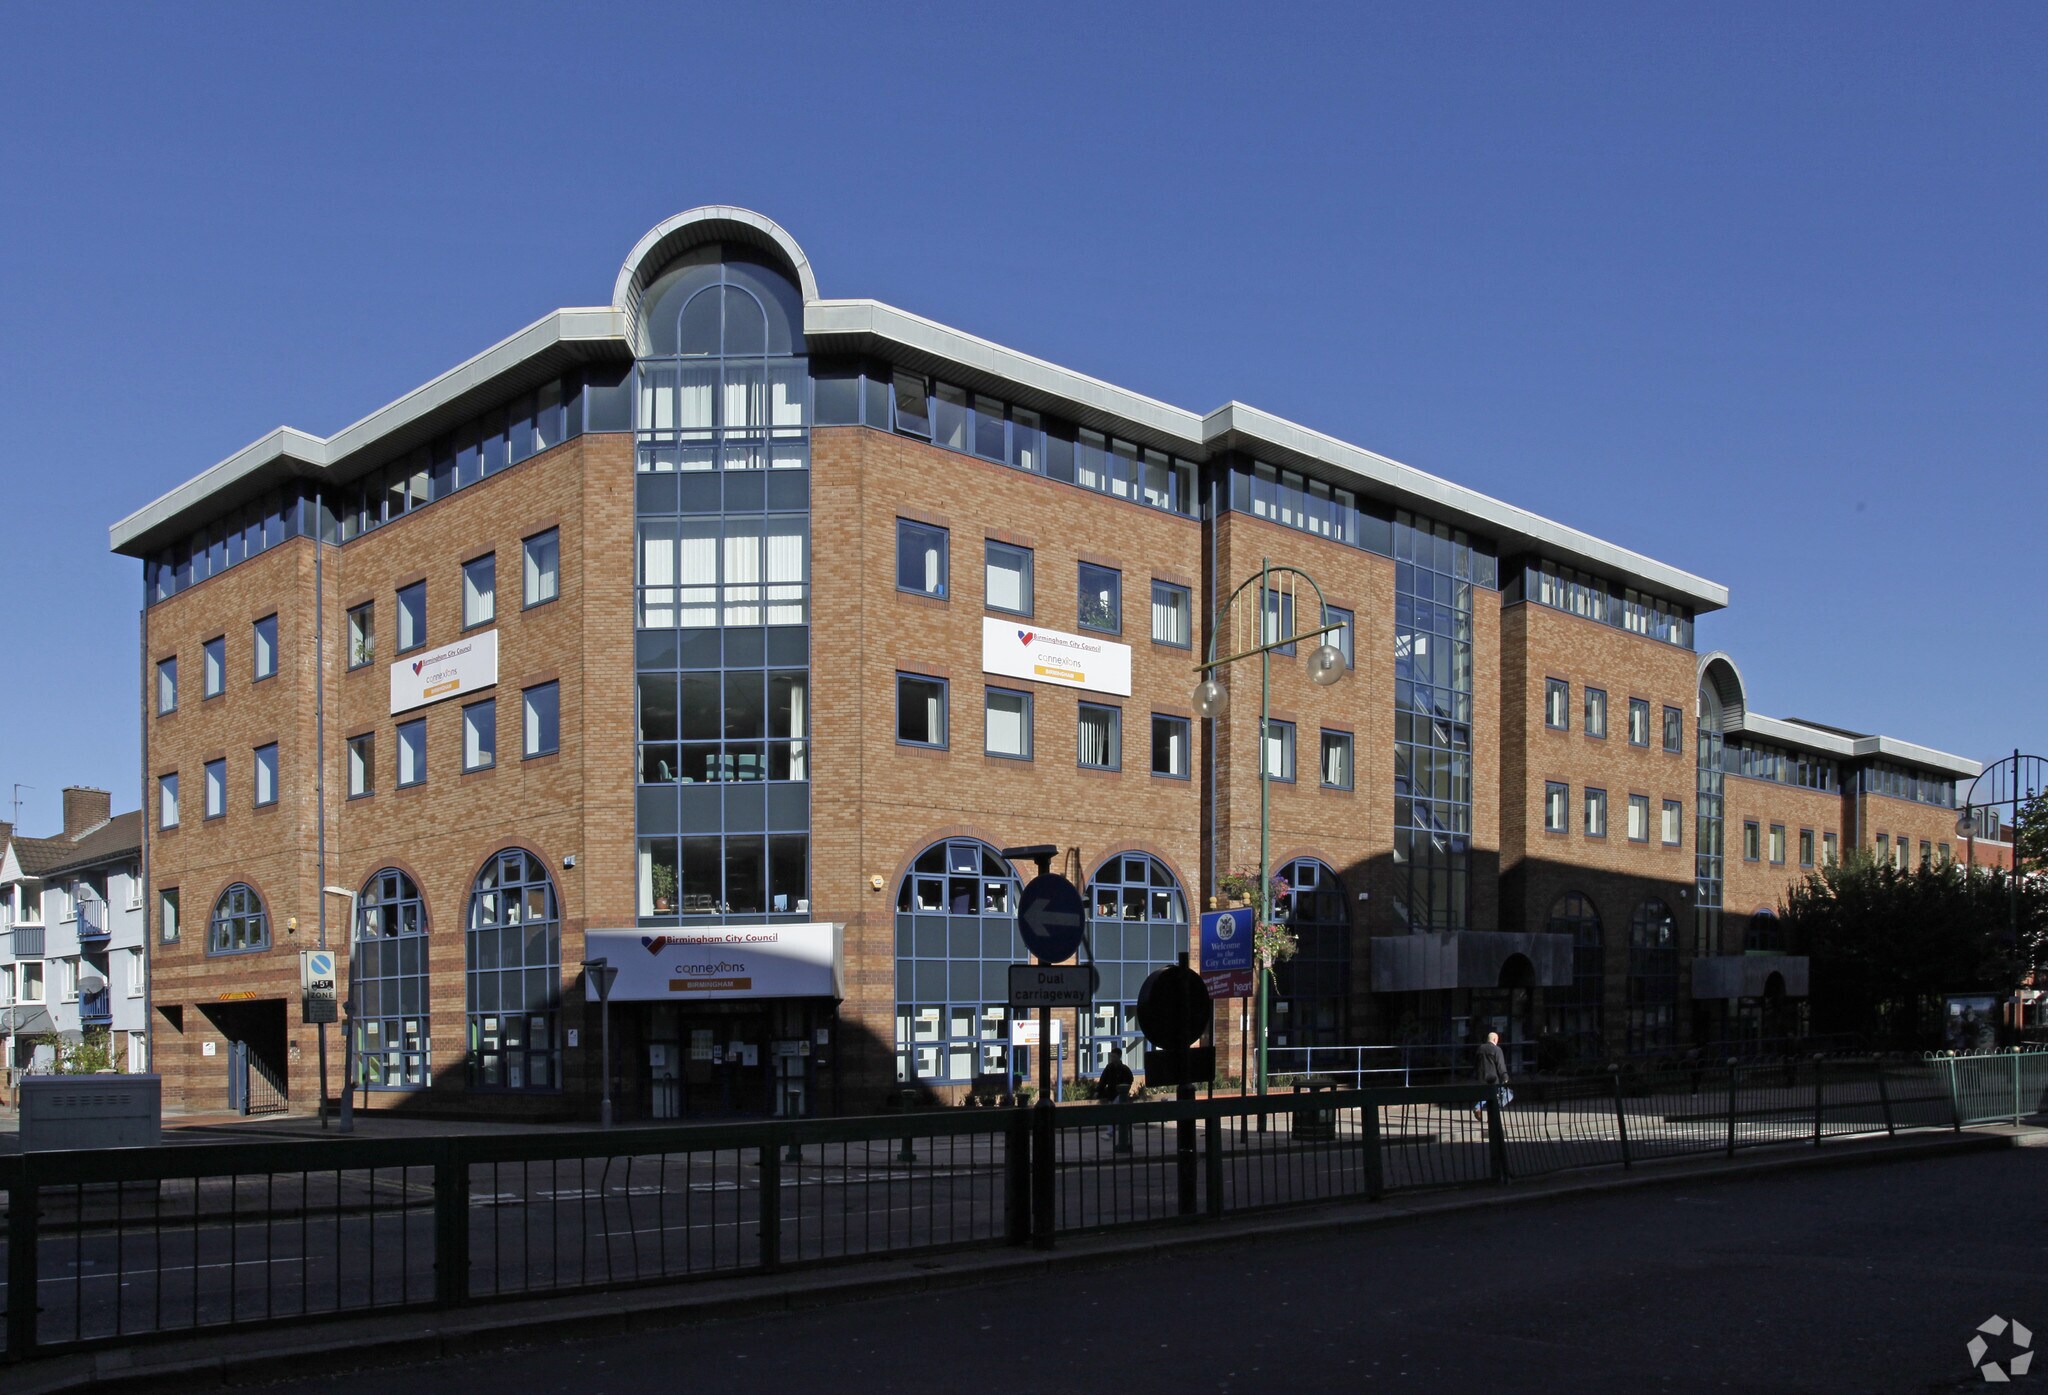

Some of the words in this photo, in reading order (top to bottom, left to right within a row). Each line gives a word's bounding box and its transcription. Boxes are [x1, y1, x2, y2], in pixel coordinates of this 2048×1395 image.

[1033, 633, 1068, 647] Birmingham
[1069, 641, 1080, 649] City
[1081, 642, 1101, 653] Council
[423, 654, 447, 666] Birmingham
[448, 650, 457, 658] City
[457, 644, 472, 655] Council
[1038, 653, 1081, 668] connexions
[426, 668, 458, 683] connexions
[666, 935, 723, 944] Birmingham
[725, 934, 743, 944] City
[745, 932, 778, 943] Council
[1211, 942, 1240, 950] Welcome
[675, 961, 745, 976] connexions
[1205, 960, 1219, 968] City
[1222, 958, 1246, 966] Centre
[1038, 973, 1065, 984] Dual
[687, 981, 734, 989] BIRMINGHAM
[1234, 981, 1252, 991] heart
[1015, 988, 1085, 1001] carriageway
